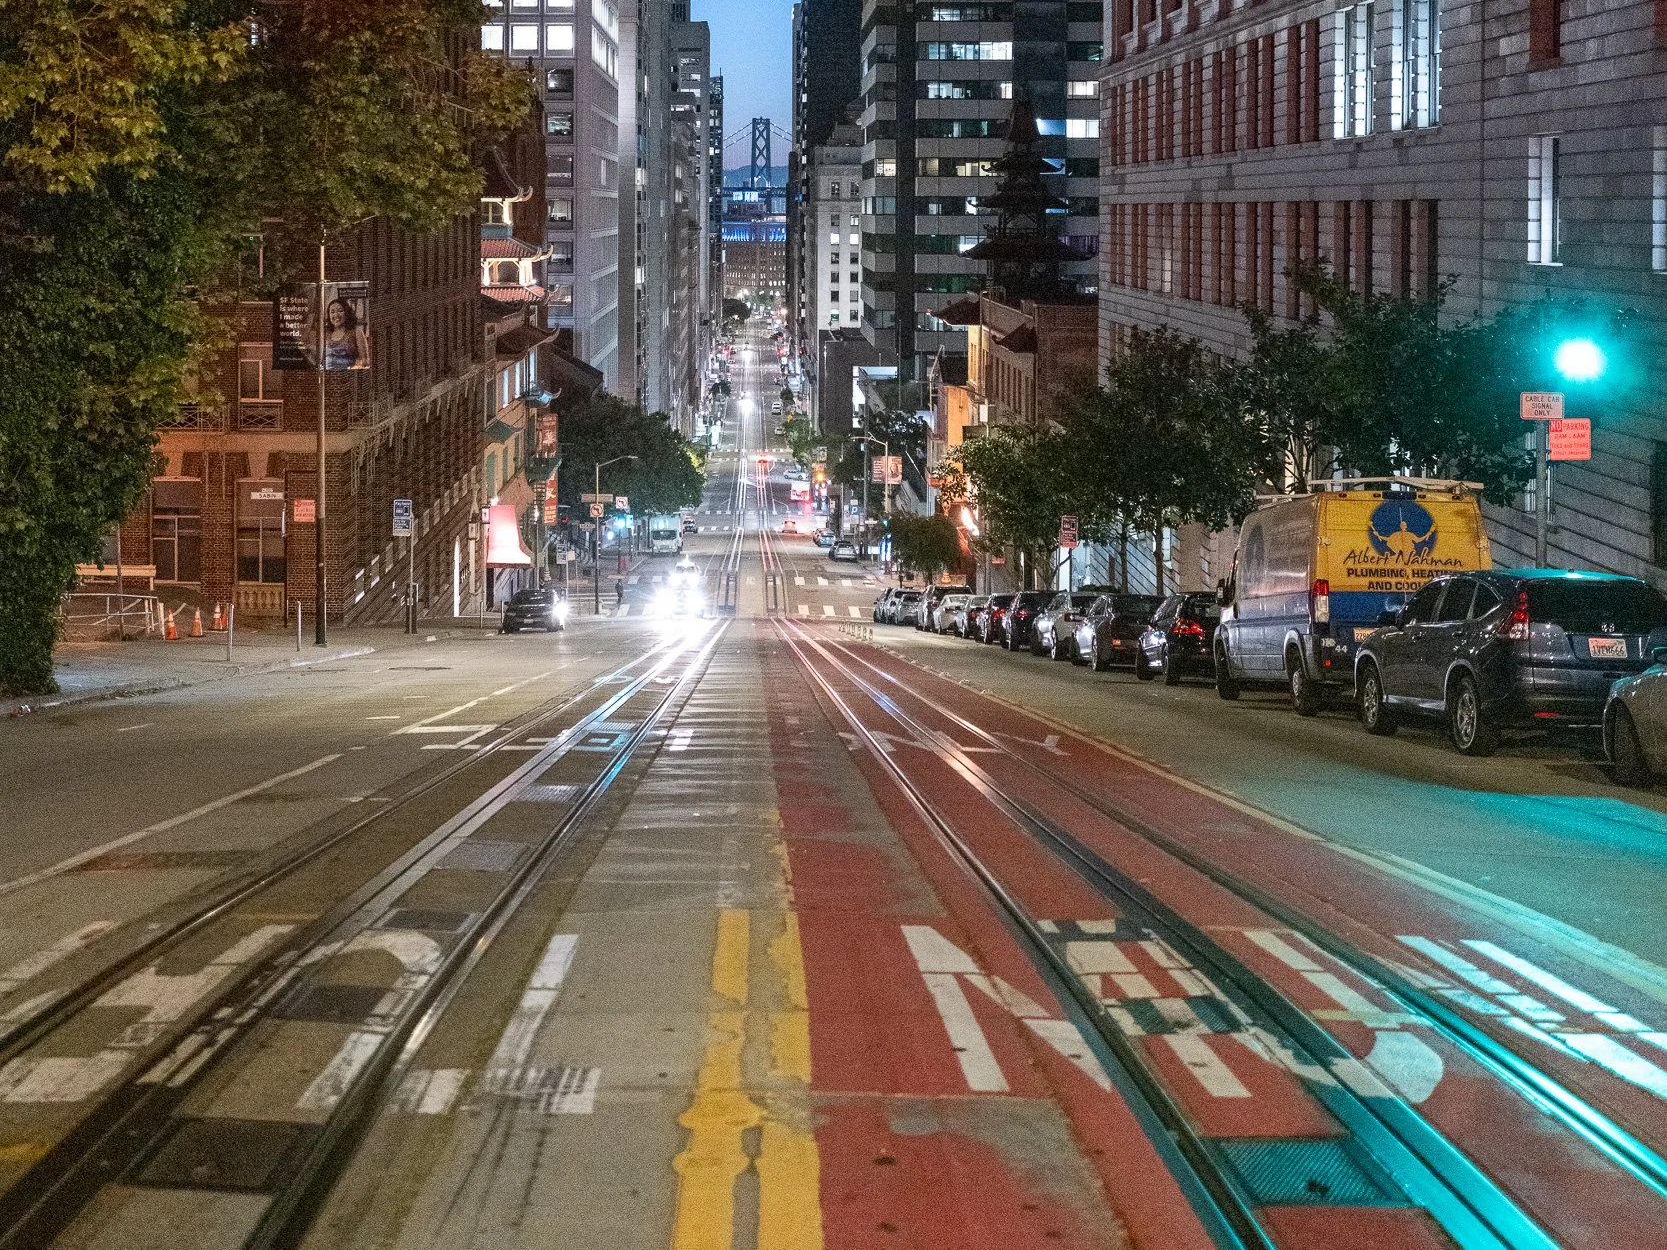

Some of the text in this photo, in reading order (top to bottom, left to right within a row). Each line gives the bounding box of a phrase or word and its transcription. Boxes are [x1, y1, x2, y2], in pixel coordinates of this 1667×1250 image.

[1551, 420, 1562, 432] NO
[1343, 547, 1464, 567] Albert Nahman
[1347, 568, 1409, 579] PLUMBING,
[1368, 581, 1392, 590] AND
